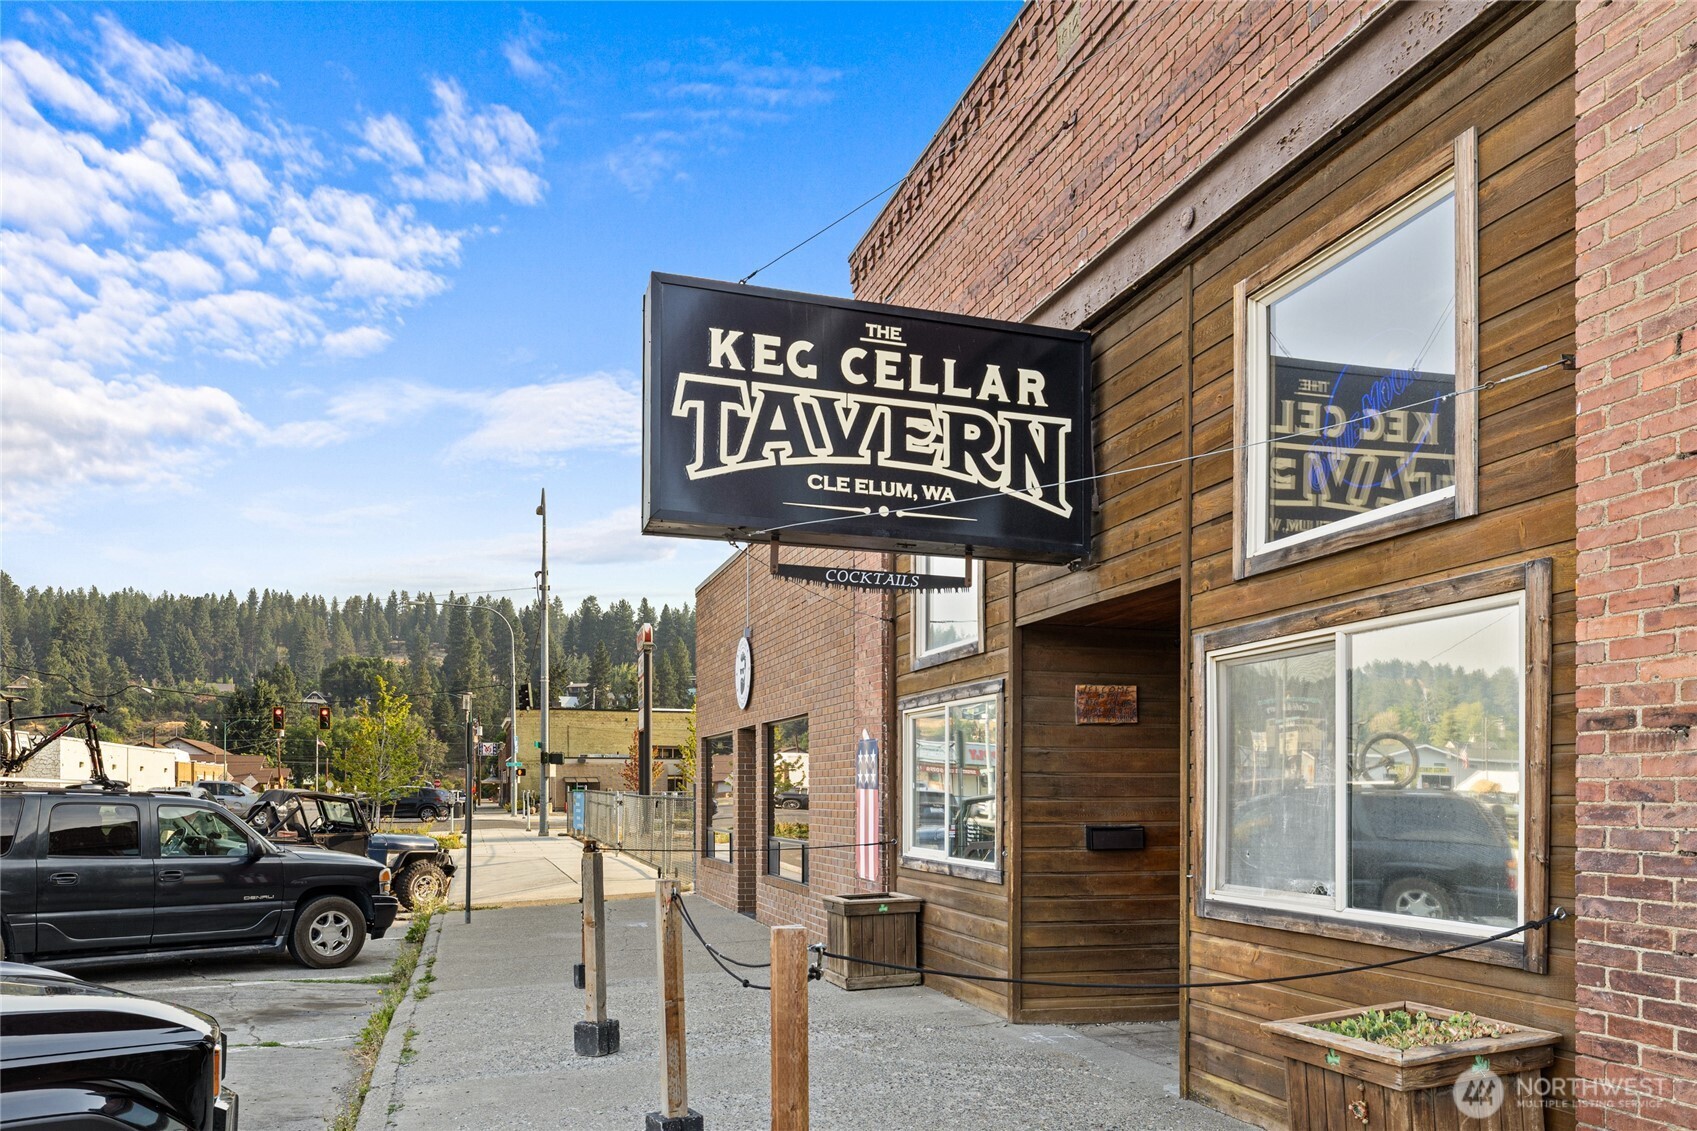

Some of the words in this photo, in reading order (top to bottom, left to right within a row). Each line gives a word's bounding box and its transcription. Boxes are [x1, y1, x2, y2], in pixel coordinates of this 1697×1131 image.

[865, 322, 902, 342] THE
[708, 327, 818, 381] KEG
[841, 347, 1049, 407] CELLAR
[671, 371, 1074, 520] TAVERN
[807, 474, 850, 493] CLE
[855, 478, 918, 501] ELUM,
[922, 485, 956, 502] WA
[825, 569, 921, 588] COCKTAILS
